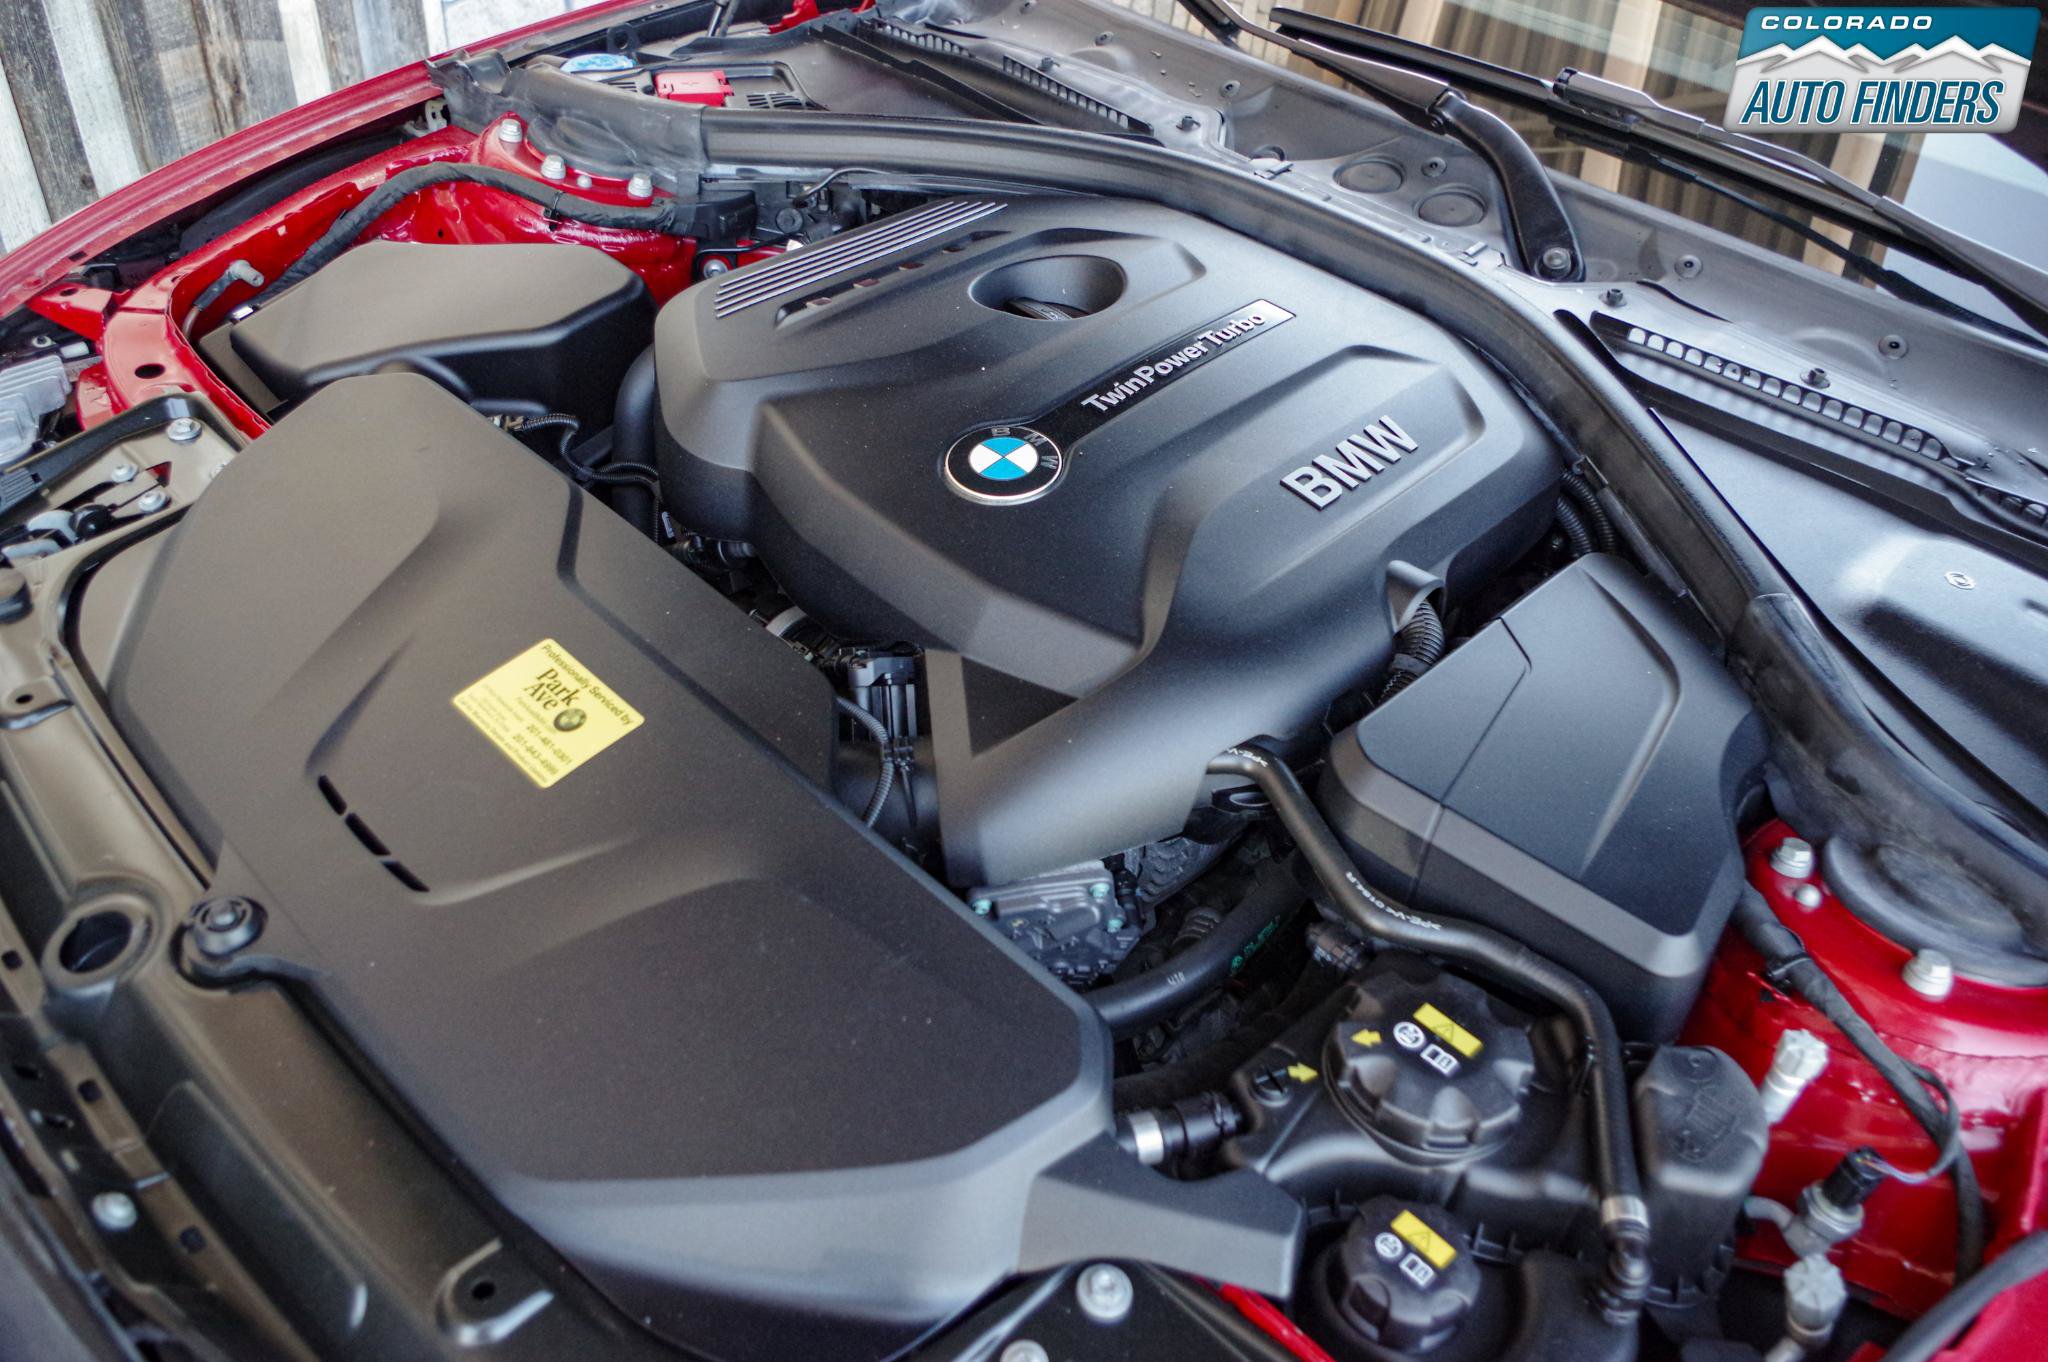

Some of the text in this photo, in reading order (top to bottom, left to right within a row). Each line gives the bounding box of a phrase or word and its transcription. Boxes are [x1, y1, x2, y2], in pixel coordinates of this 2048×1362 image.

[1081, 311, 1267, 412] TwinPowerTurbo
[990, 426, 1060, 470] BMW
[1279, 414, 1419, 511] BMW
[523, 681, 559, 710] Ave
[536, 668, 582, 706] Park
[541, 644, 590, 688] Professionally
[588, 686, 625, 716] Serviced
[619, 712, 633, 726] by
